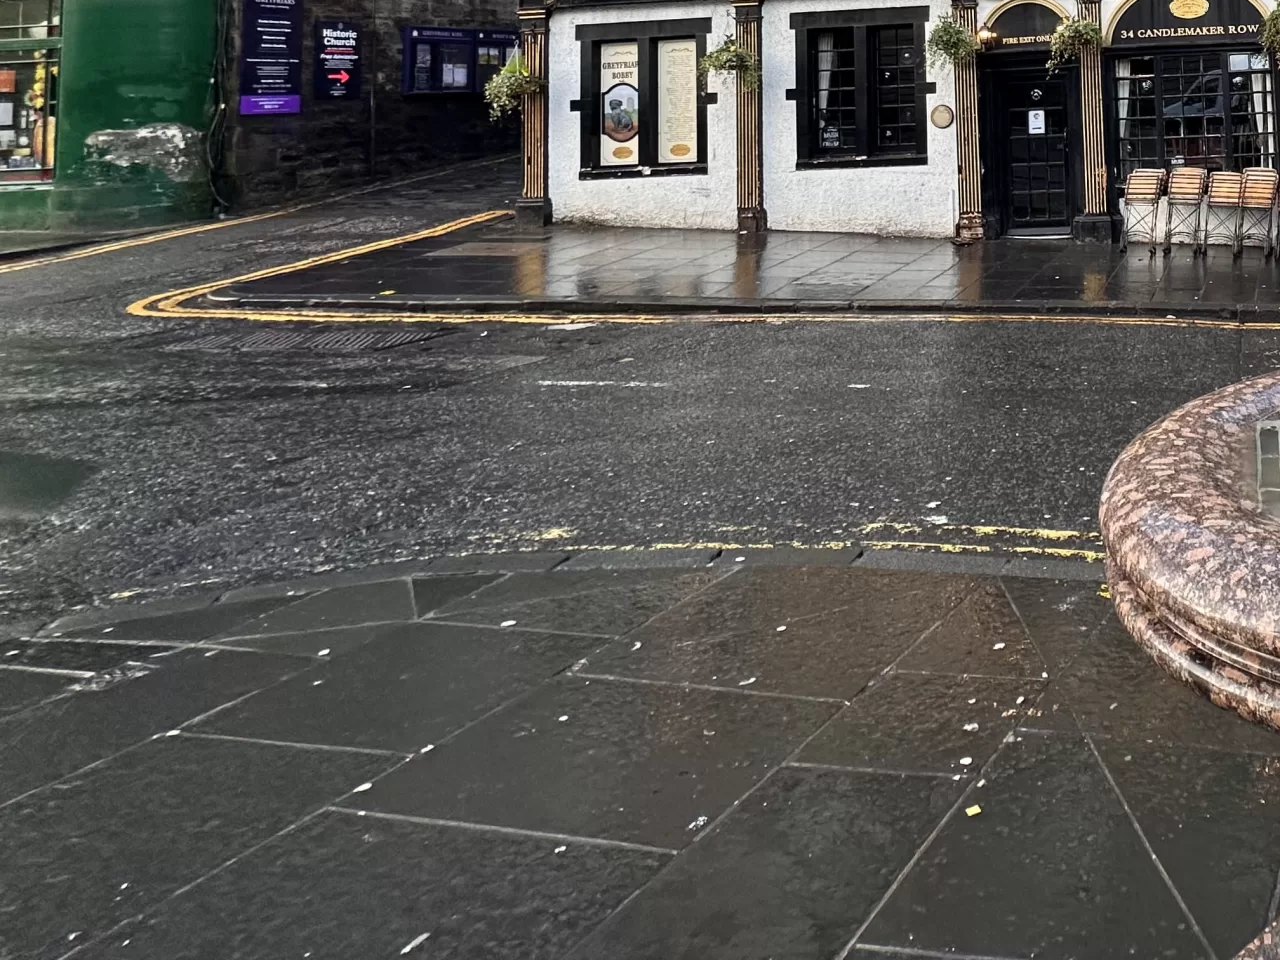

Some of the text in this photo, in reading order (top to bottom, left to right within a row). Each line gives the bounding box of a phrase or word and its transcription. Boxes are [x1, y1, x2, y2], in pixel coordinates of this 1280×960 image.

[322, 28, 357, 38] Historic
[1120, 24, 1260, 39] 34 CANDLEMAKER ROW
[323, 37, 356, 46] Church
[1002, 37, 1019, 45] FIRE
[1019, 36, 1036, 44] EXIT
[603, 61, 639, 70] GREYFRIAR
